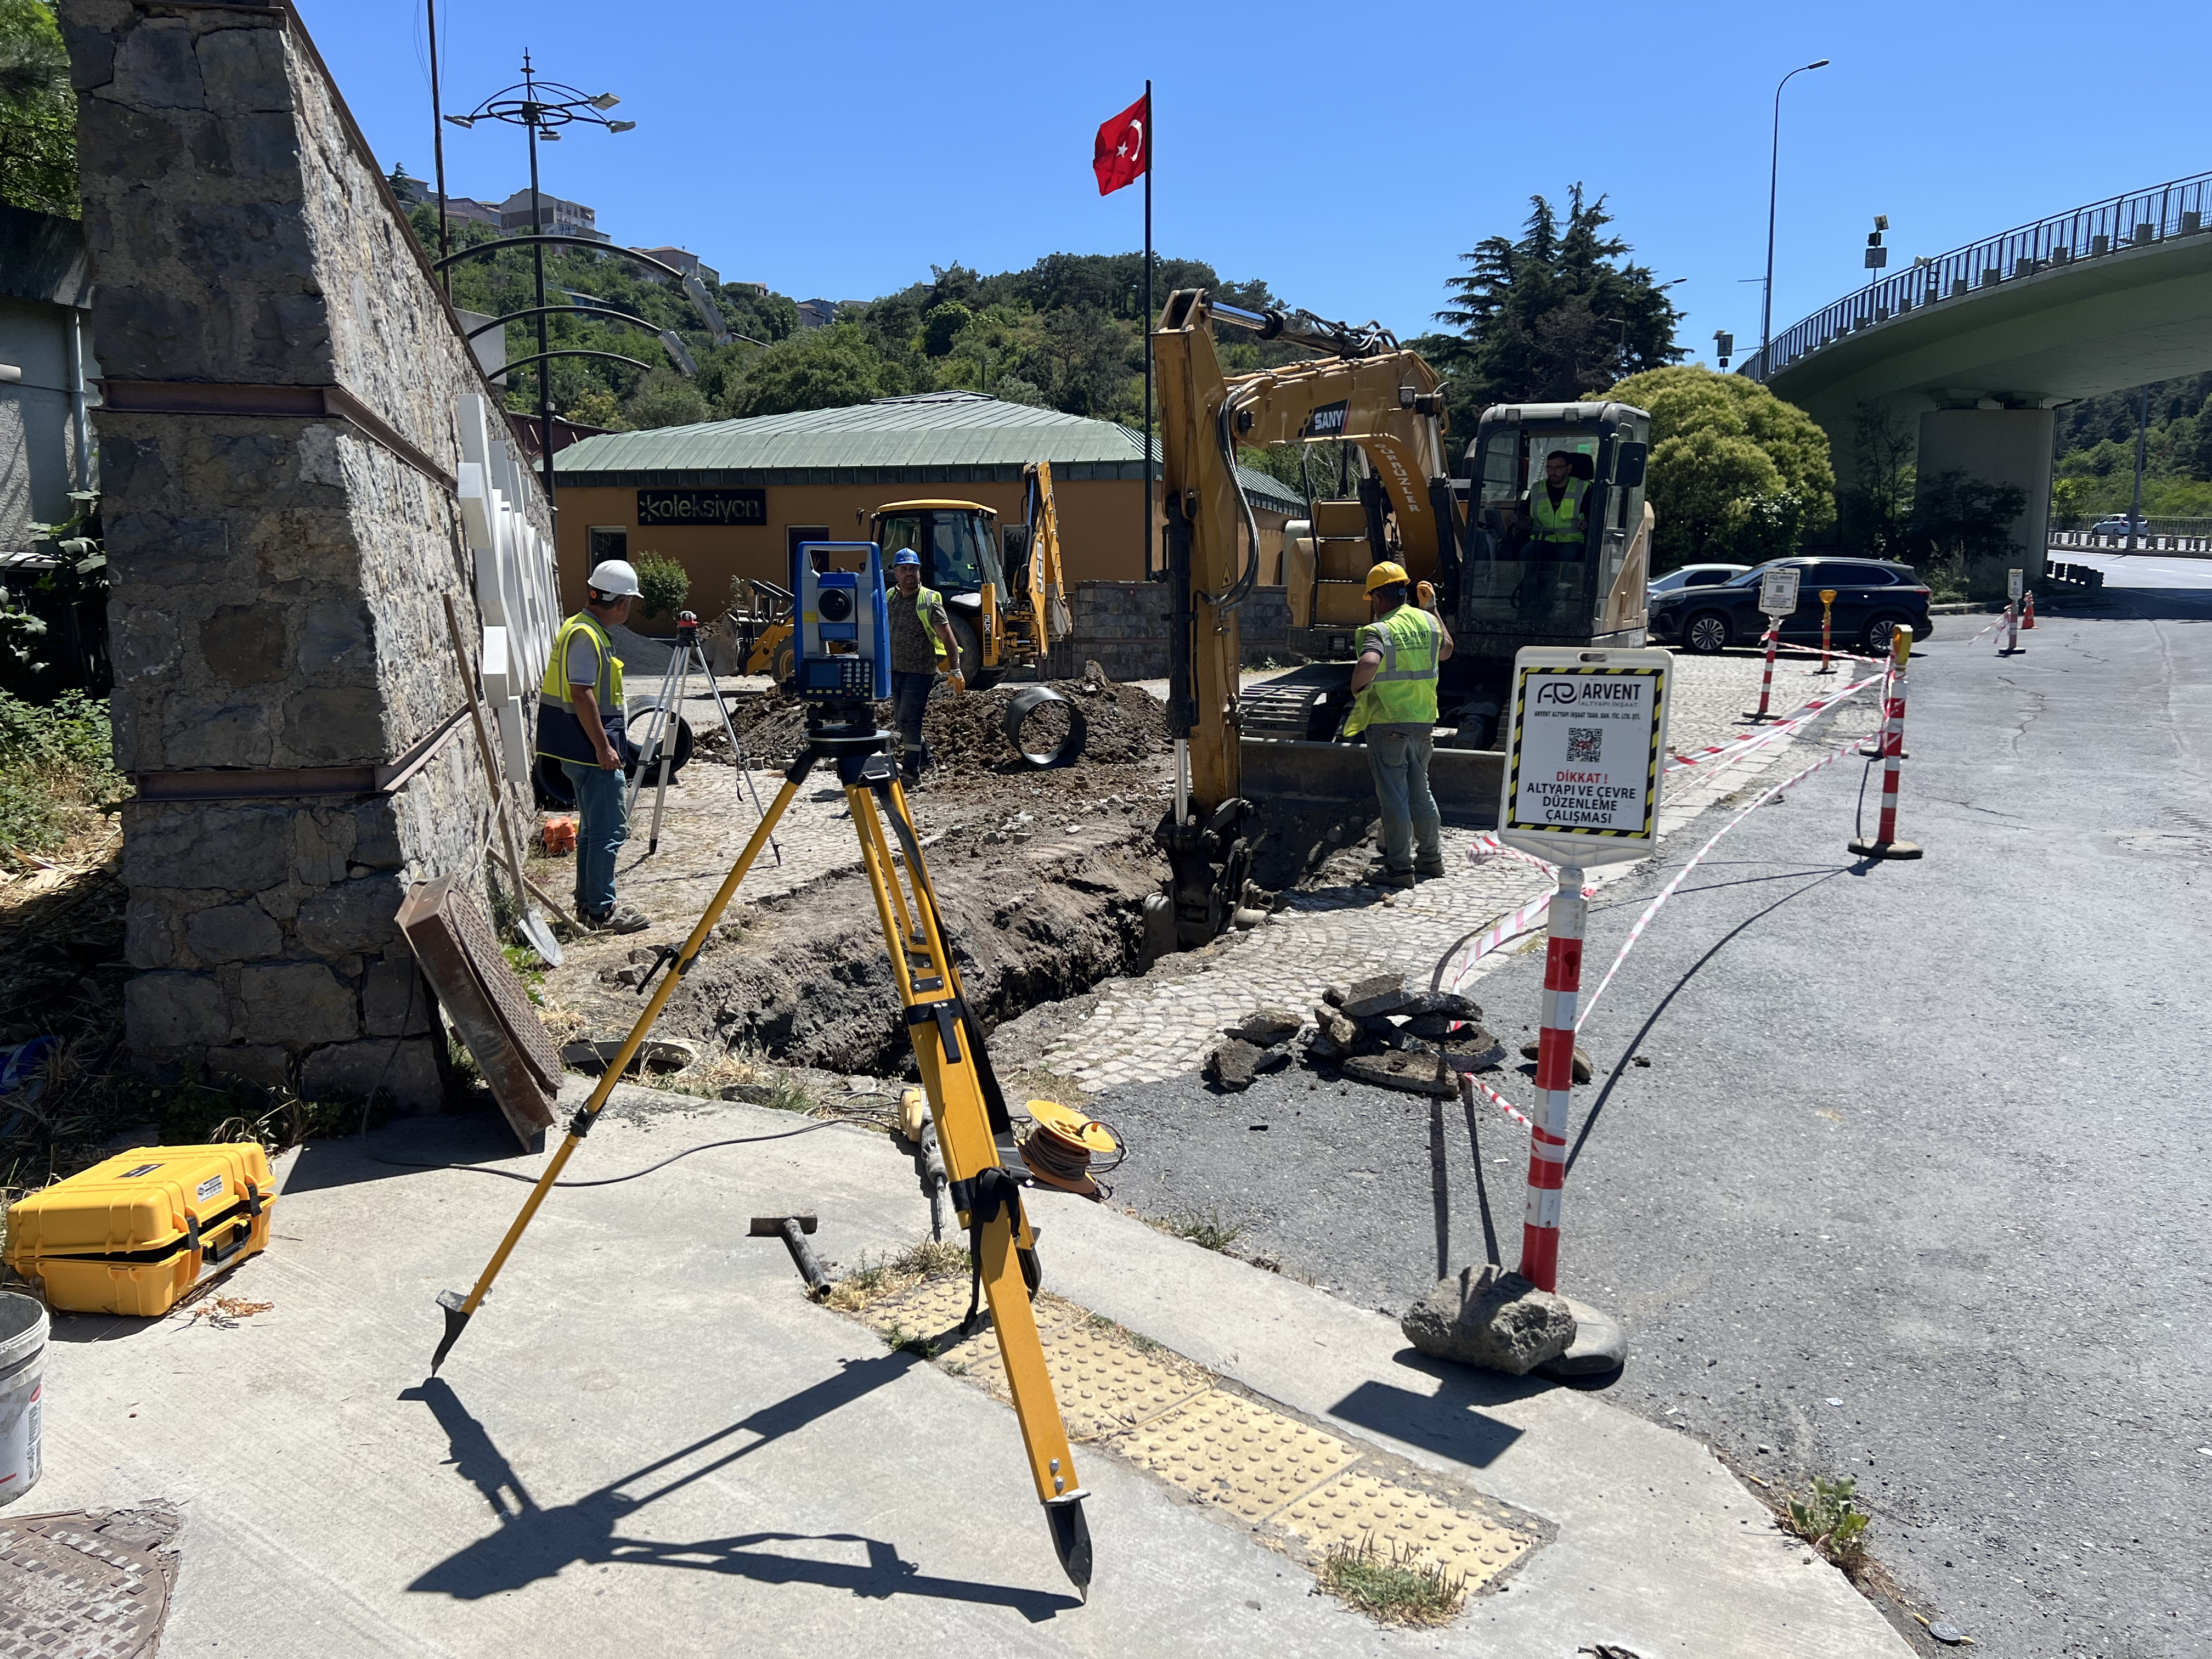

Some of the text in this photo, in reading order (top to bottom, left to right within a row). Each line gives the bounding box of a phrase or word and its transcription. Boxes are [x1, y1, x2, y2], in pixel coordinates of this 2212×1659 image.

[1314, 409, 1343, 431] SANY
[640, 494, 760, 522] koleksiyon
[1582, 682, 1641, 700] ARVENT
[1556, 769, 1608, 784] DİKKAT !
[1527, 783, 1636, 800] ALTYAPI VE ÇEVRE
[1543, 794, 1618, 811] DÜZENLEME
[1546, 809, 1612, 824] ÇALIŞMASI
